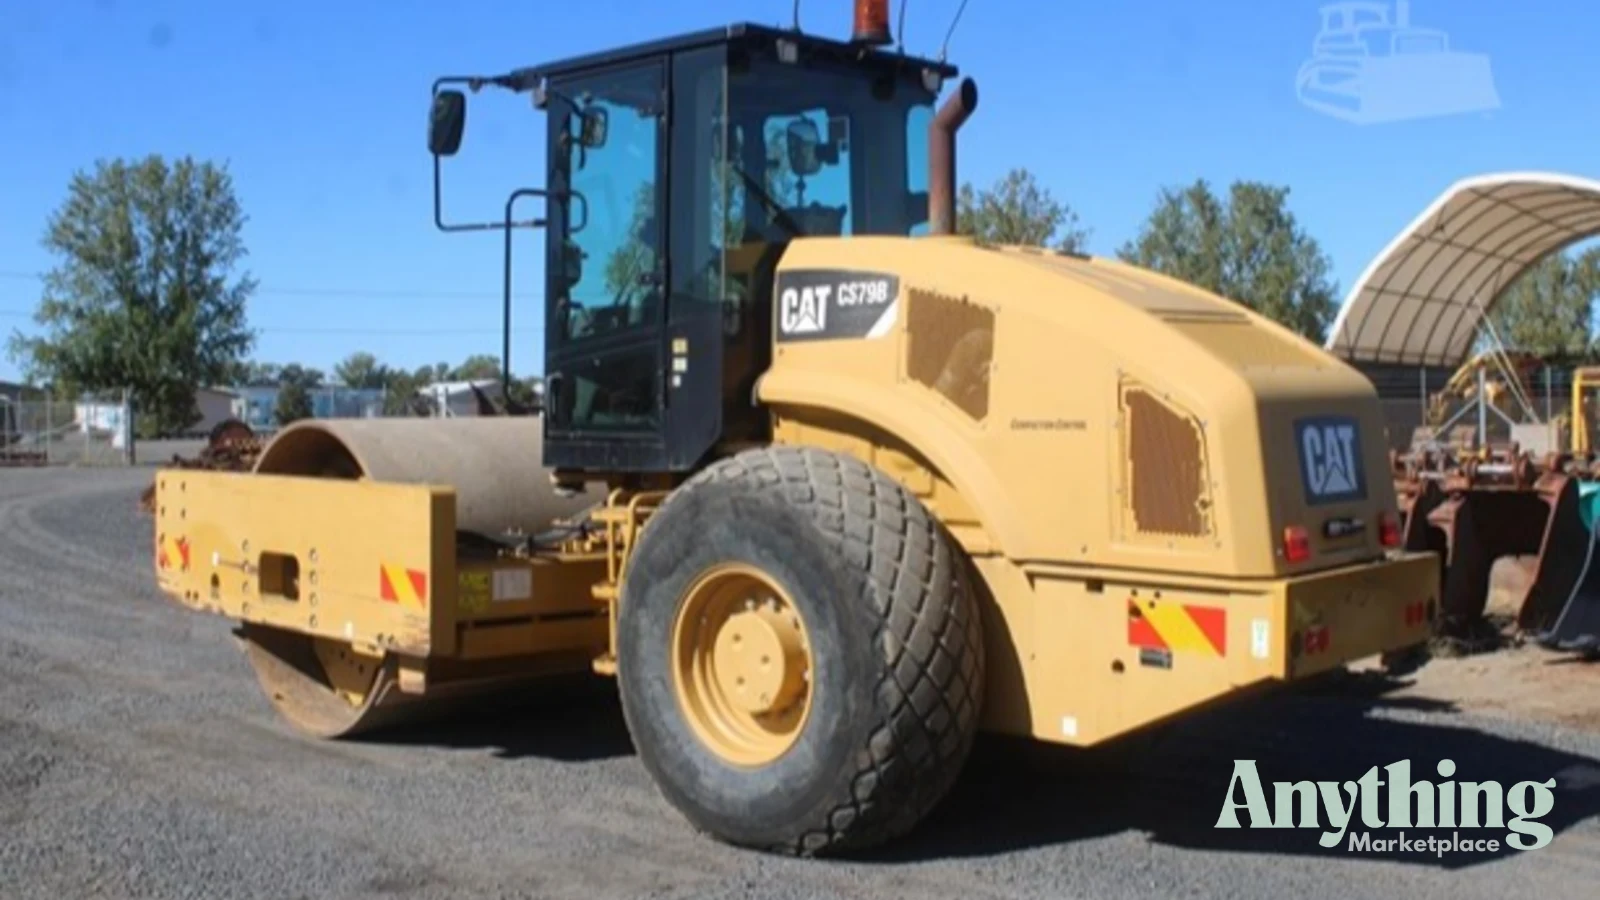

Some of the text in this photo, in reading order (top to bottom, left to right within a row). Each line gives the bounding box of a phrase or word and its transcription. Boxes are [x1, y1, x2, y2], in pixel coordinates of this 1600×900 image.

[781, 280, 888, 333] CAT CS79B
[1302, 424, 1358, 495] CAT
